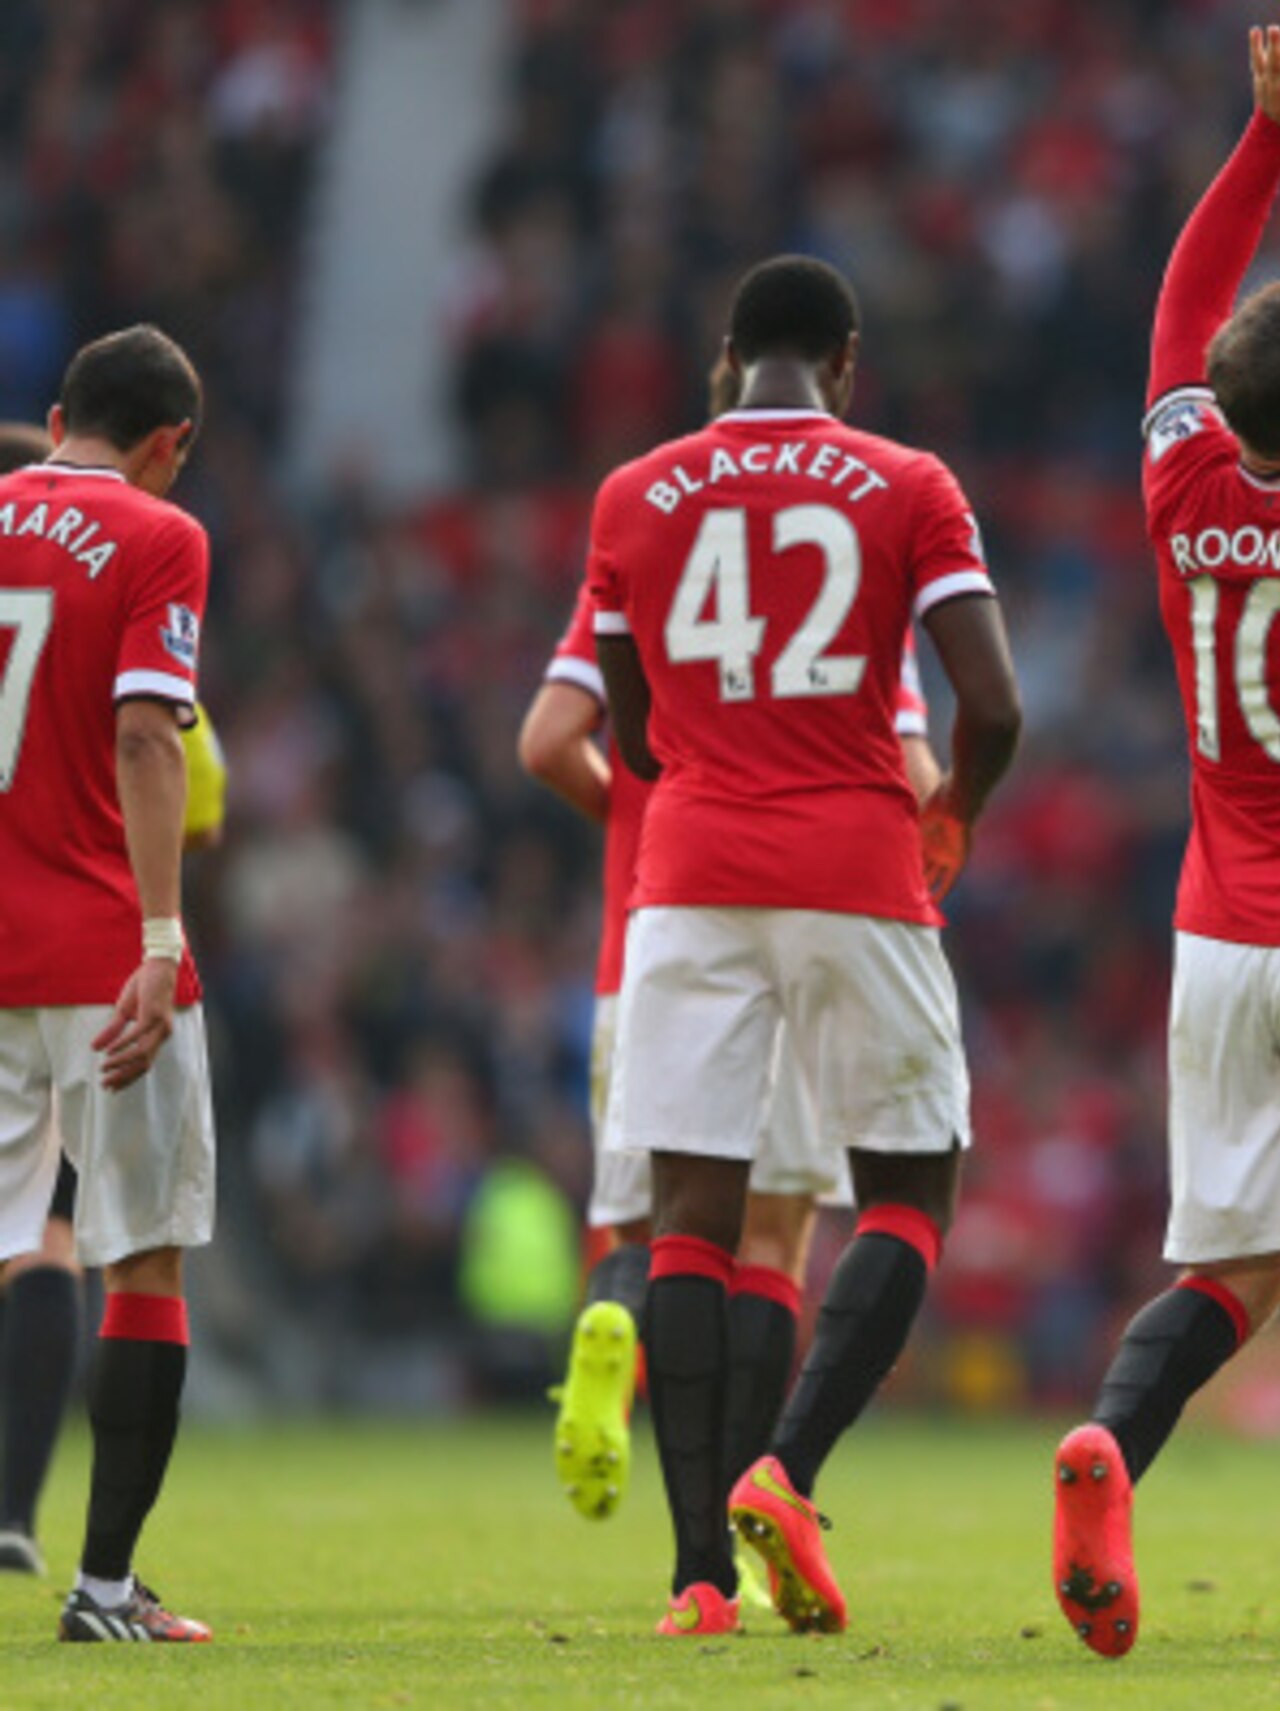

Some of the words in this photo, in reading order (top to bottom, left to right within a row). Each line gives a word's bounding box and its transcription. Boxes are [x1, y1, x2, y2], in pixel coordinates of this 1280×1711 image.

[644, 441, 889, 515] BLACKETT
[0, 588, 55, 794] 7
[664, 503, 868, 703] 42
